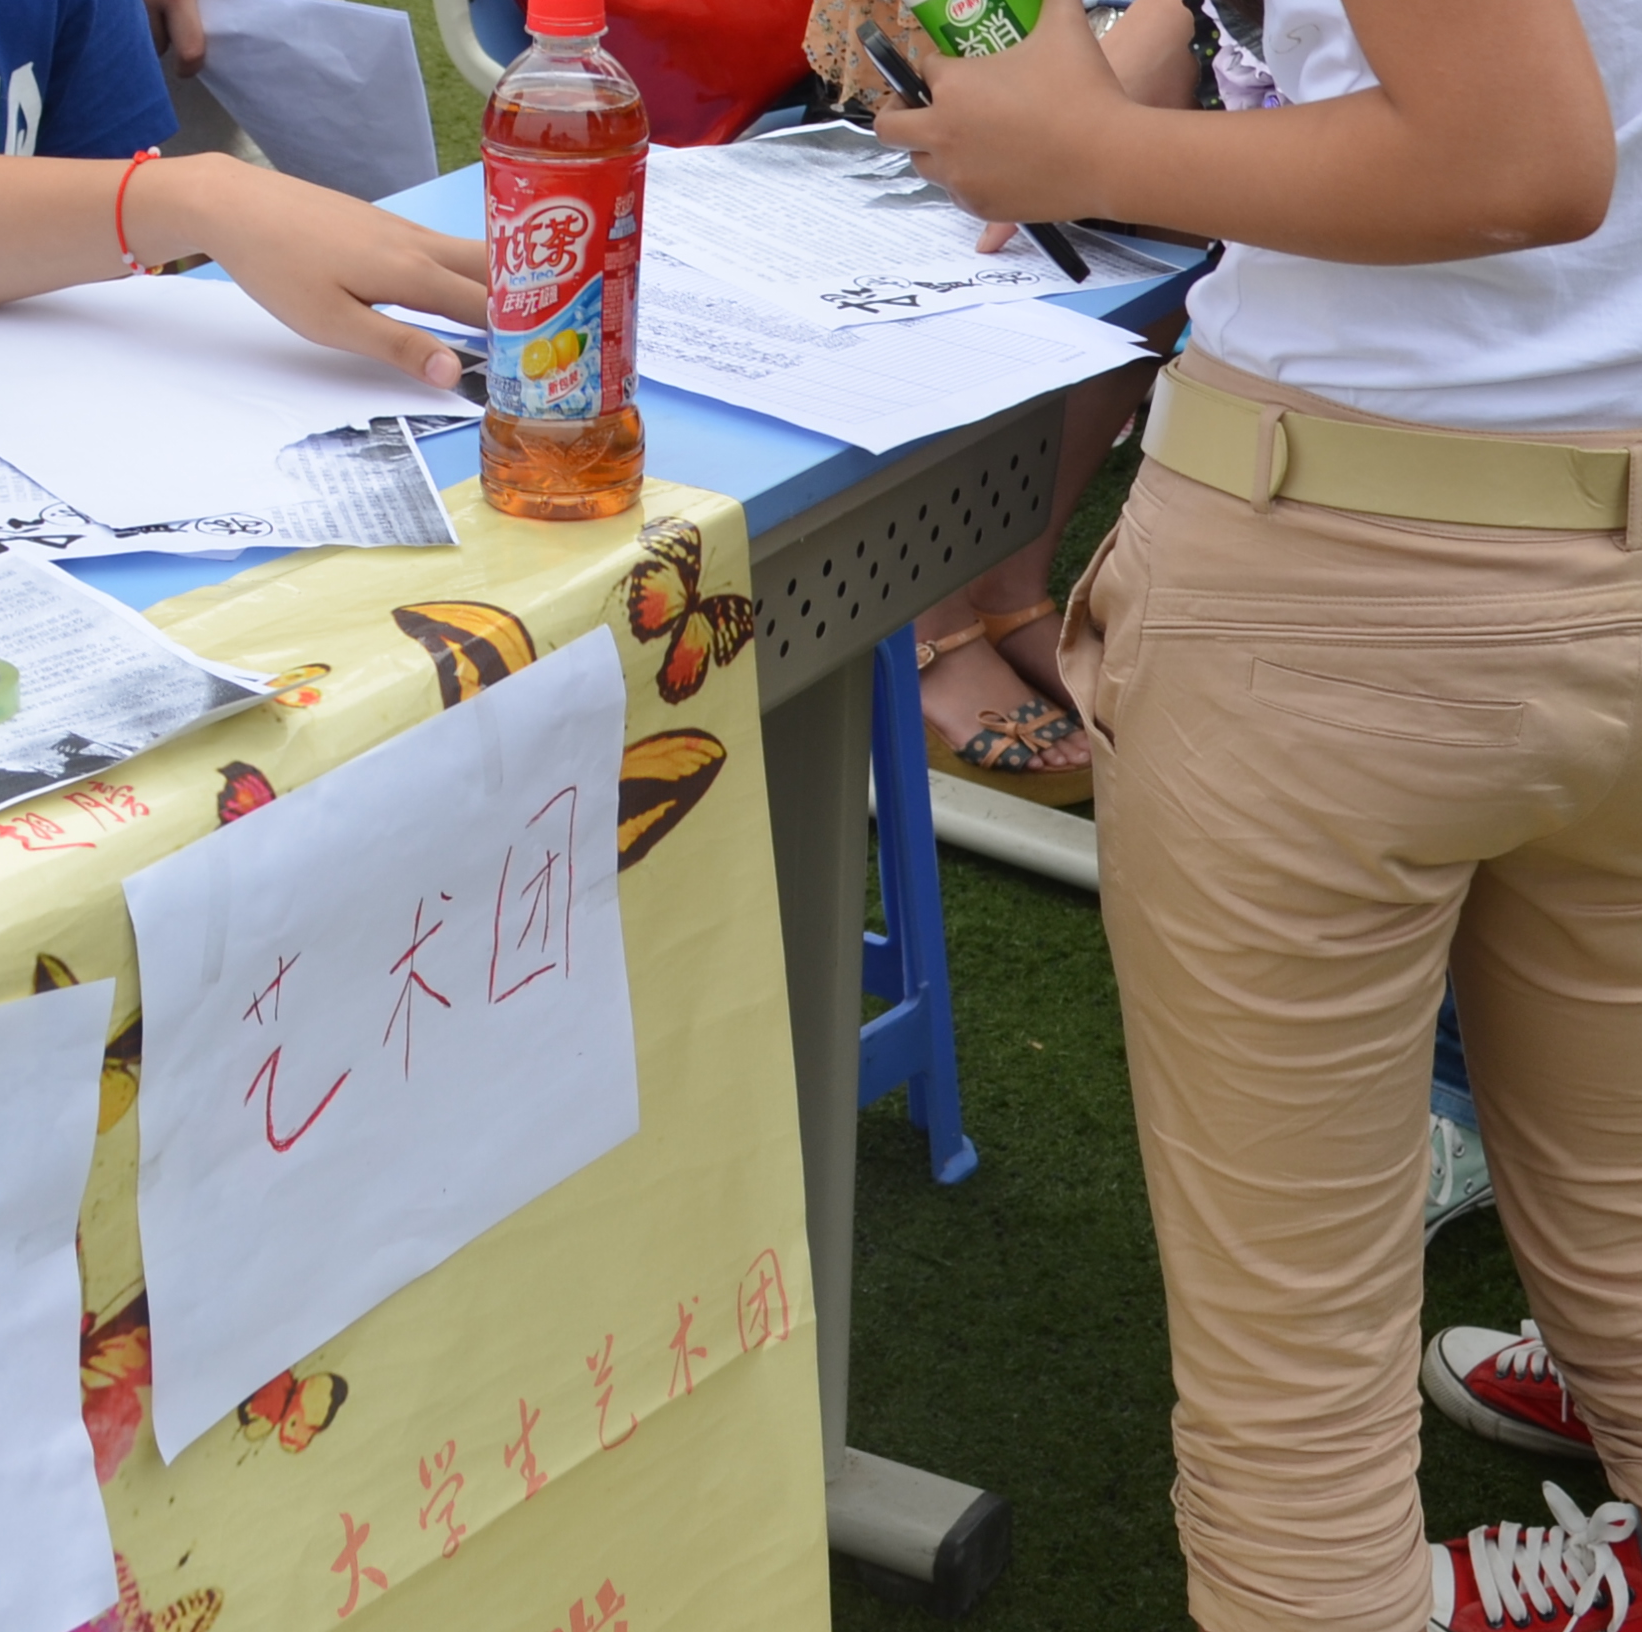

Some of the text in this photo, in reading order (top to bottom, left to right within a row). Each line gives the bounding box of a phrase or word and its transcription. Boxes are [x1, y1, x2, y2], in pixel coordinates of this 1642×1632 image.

[508, 276, 527, 286] Ice
[243, 784, 577, 1153] 艺术团
[330, 1248, 791, 1619] 大学生艺术团
